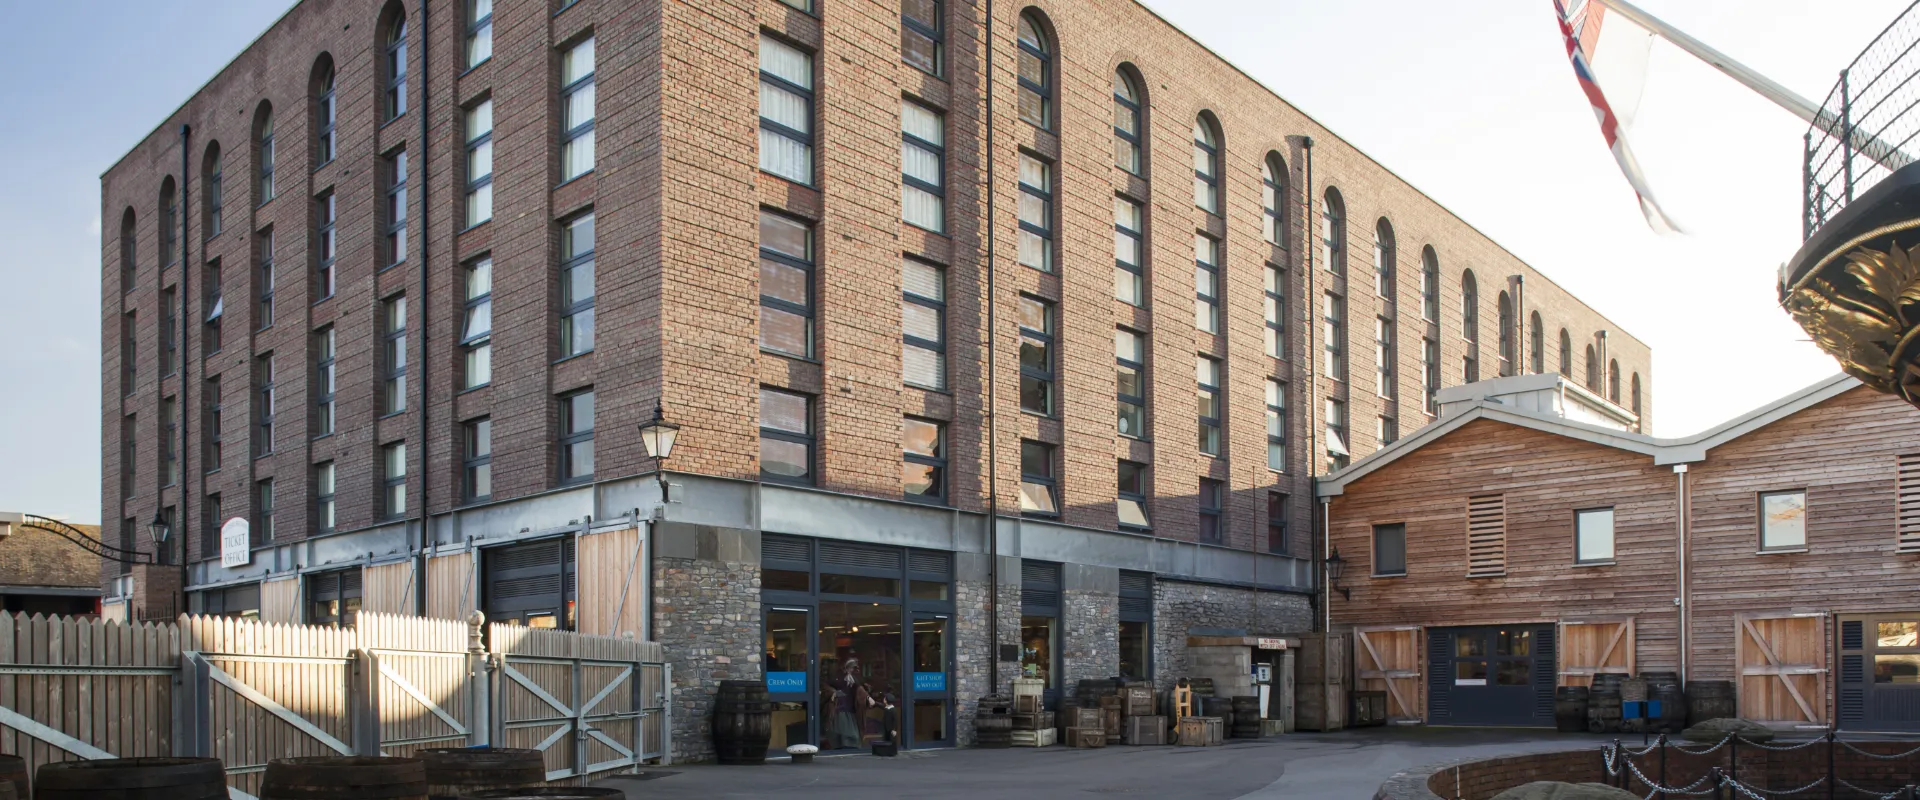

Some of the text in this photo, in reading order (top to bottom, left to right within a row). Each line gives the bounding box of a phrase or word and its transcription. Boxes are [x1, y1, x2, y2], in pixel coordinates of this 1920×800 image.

[224, 533, 245, 548] TICKET
[224, 550, 245, 564] OFFICE
[767, 678, 804, 686] CREW ONLY
